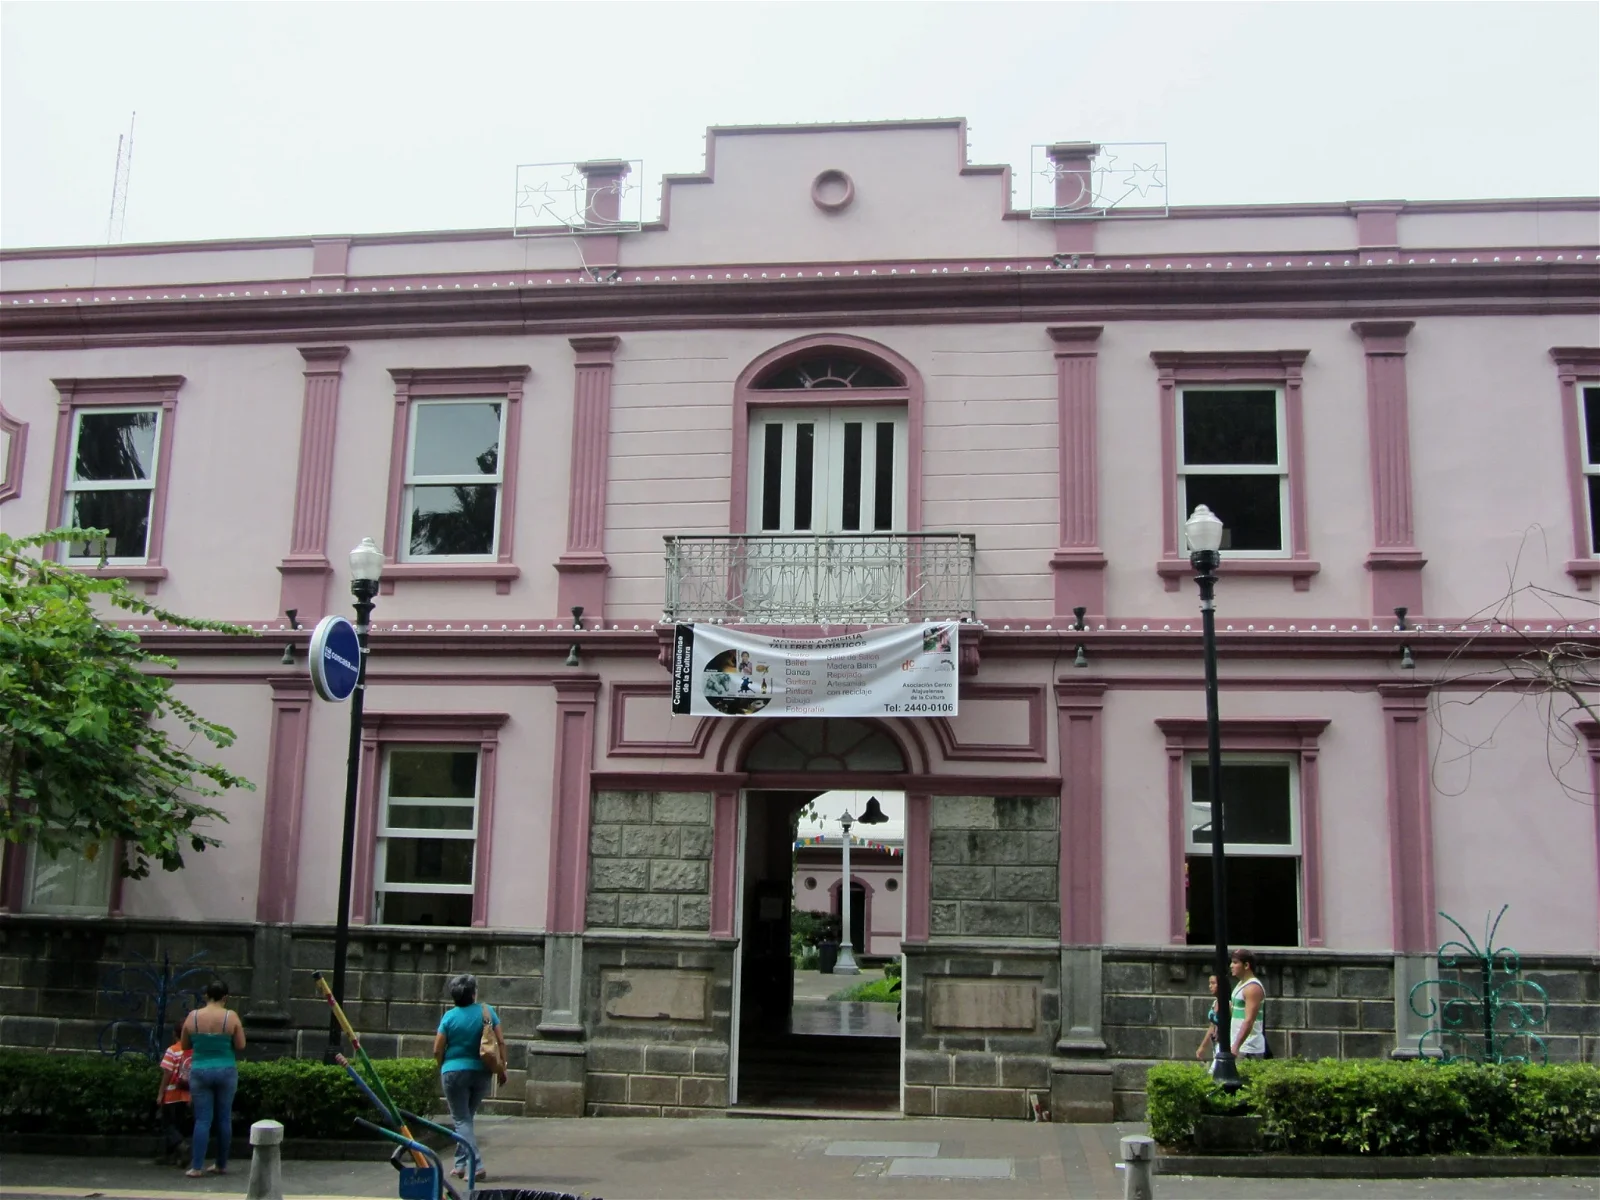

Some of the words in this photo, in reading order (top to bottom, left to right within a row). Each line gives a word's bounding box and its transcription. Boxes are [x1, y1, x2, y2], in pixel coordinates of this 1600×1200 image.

[675, 636, 684, 679] Alajuelense
[683, 646, 691, 672] Cultura
[826, 662, 855, 670] Madera
[856, 661, 877, 669] Balsa
[785, 668, 811, 676] Danza
[683, 674, 690, 682] la
[785, 678, 817, 686] Guitarra
[683, 683, 689, 693] de
[785, 687, 813, 695] Pintura
[673, 681, 681, 705] Centro
[842, 689, 873, 697] reciclaje
[785, 697, 811, 705] Dibujo
[884, 703, 901, 712] Tel:
[904, 703, 954, 712] 2440-0106
